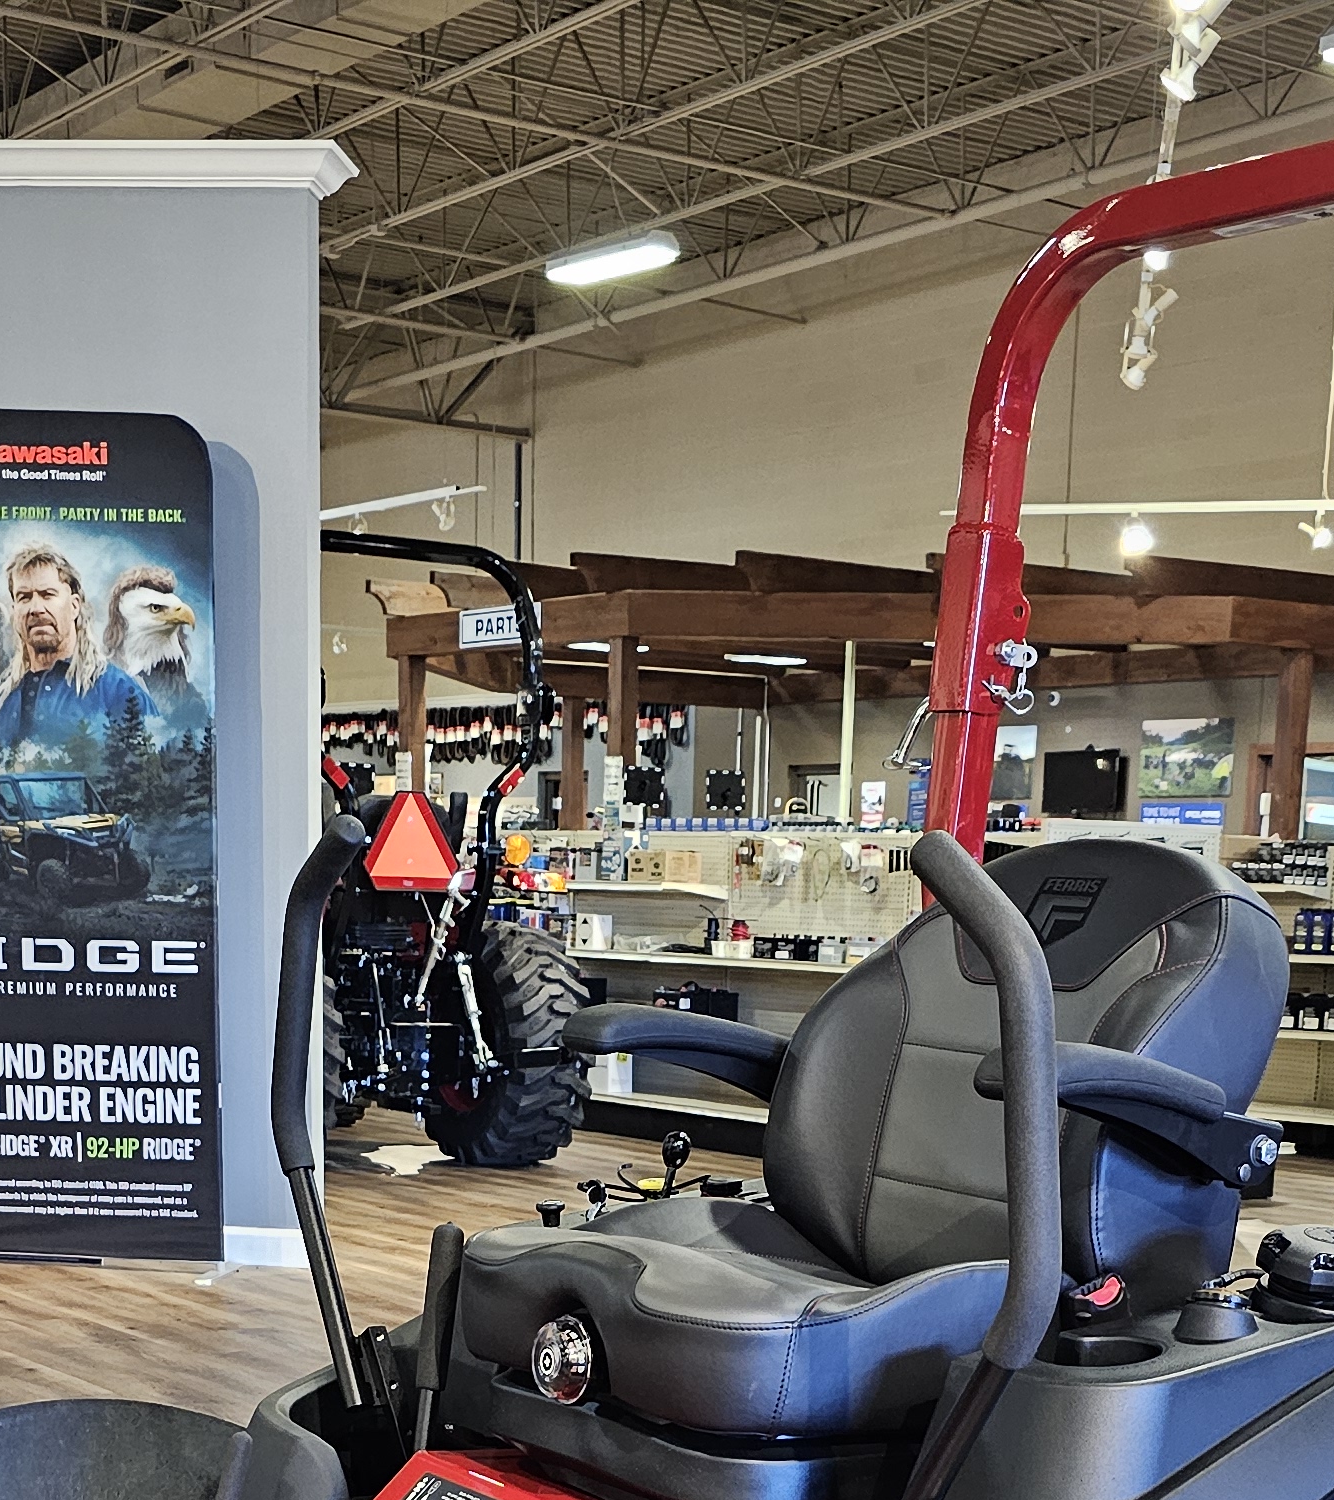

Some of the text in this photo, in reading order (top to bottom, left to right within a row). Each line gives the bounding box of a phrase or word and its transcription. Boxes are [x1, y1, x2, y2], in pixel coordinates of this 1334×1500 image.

[2, 469, 18, 480] the
[20, 469, 48, 481] Good
[49, 470, 81, 481] Times
[59, 507, 101, 522] PARTY
[104, 507, 117, 522] IN
[120, 508, 145, 523] THE
[148, 508, 186, 524] BACK.
[475, 615, 520, 637] PART
[1043, 878, 1102, 893] FERRIS
[66, 982, 178, 998] PERFORMANCE
[53, 1043, 200, 1083] BREAKING
[99, 1086, 202, 1125] ENGINE
[48, 1135, 74, 1159] XR
[86, 1136, 140, 1160] 92-HP
